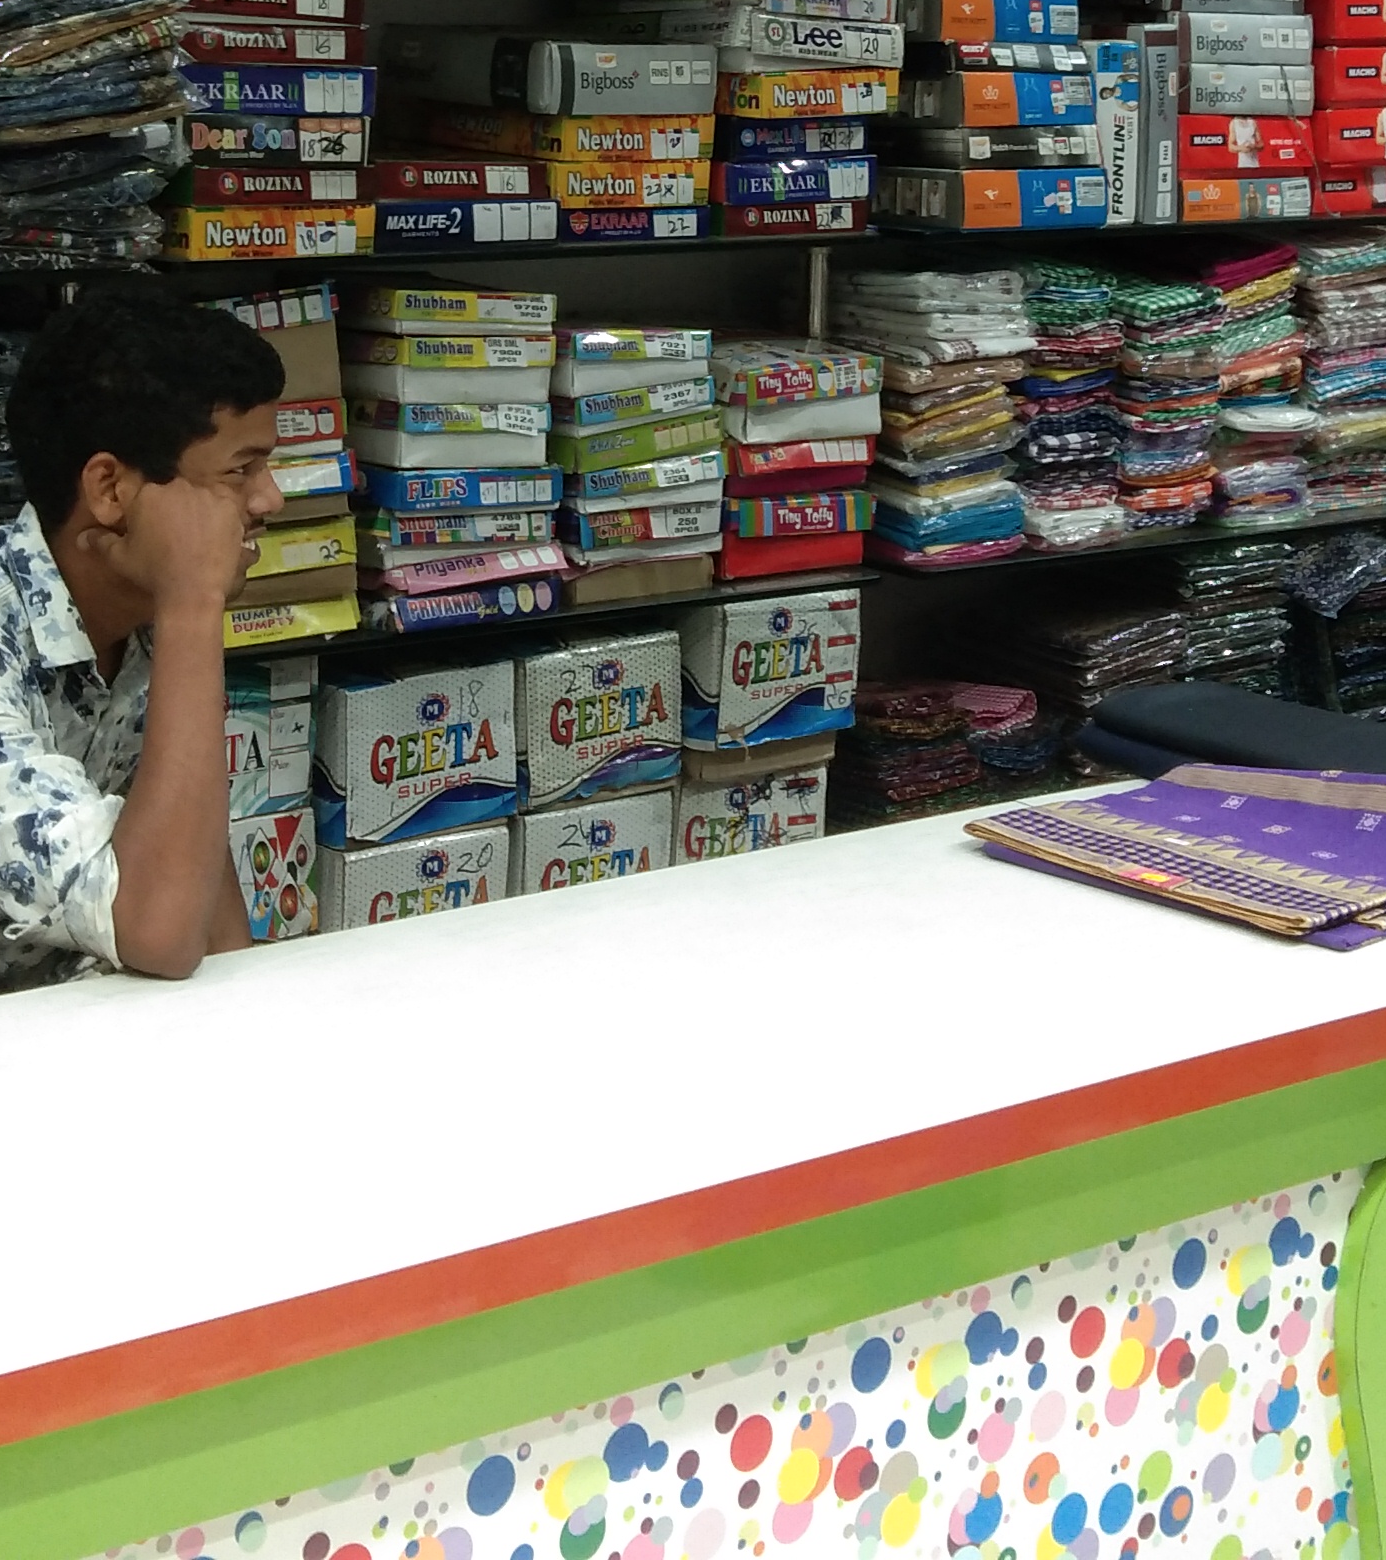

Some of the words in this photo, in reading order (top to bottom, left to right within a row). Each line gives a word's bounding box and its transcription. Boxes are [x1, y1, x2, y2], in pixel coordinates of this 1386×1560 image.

[792, 22, 843, 48] Lee
[581, 72, 634, 93] Bigboss
[773, 85, 835, 107] Newton
[1195, 87, 1242, 106] Bigboss
[577, 128, 643, 151] Newton
[1112, 114, 1125, 215] FRONTLINE
[568, 173, 635, 196] Newton
[763, 209, 810, 224] ROZINA
[206, 221, 287, 248] Newton
[405, 294, 467, 311] Shubham
[513, 302, 548, 313] 9760
[416, 339, 474, 357] Shubham
[660, 341, 687, 350] 7921
[584, 394, 644, 414] Shubham
[589, 469, 651, 489] Shubham
[663, 466, 687, 477] 2364
[407, 478, 468, 501] FLIPS
[597, 522, 644, 540] Chump
[413, 555, 486, 578] Priyanka
[233, 616, 294, 634] DUMPTY
[732, 634, 825, 689] GEETA
[751, 684, 804, 699] SUPER
[550, 683, 668, 749] GEETA
[370, 719, 499, 788] GEETA
[576, 735, 645, 760] SUPER
[398, 772, 472, 799] SUPER
